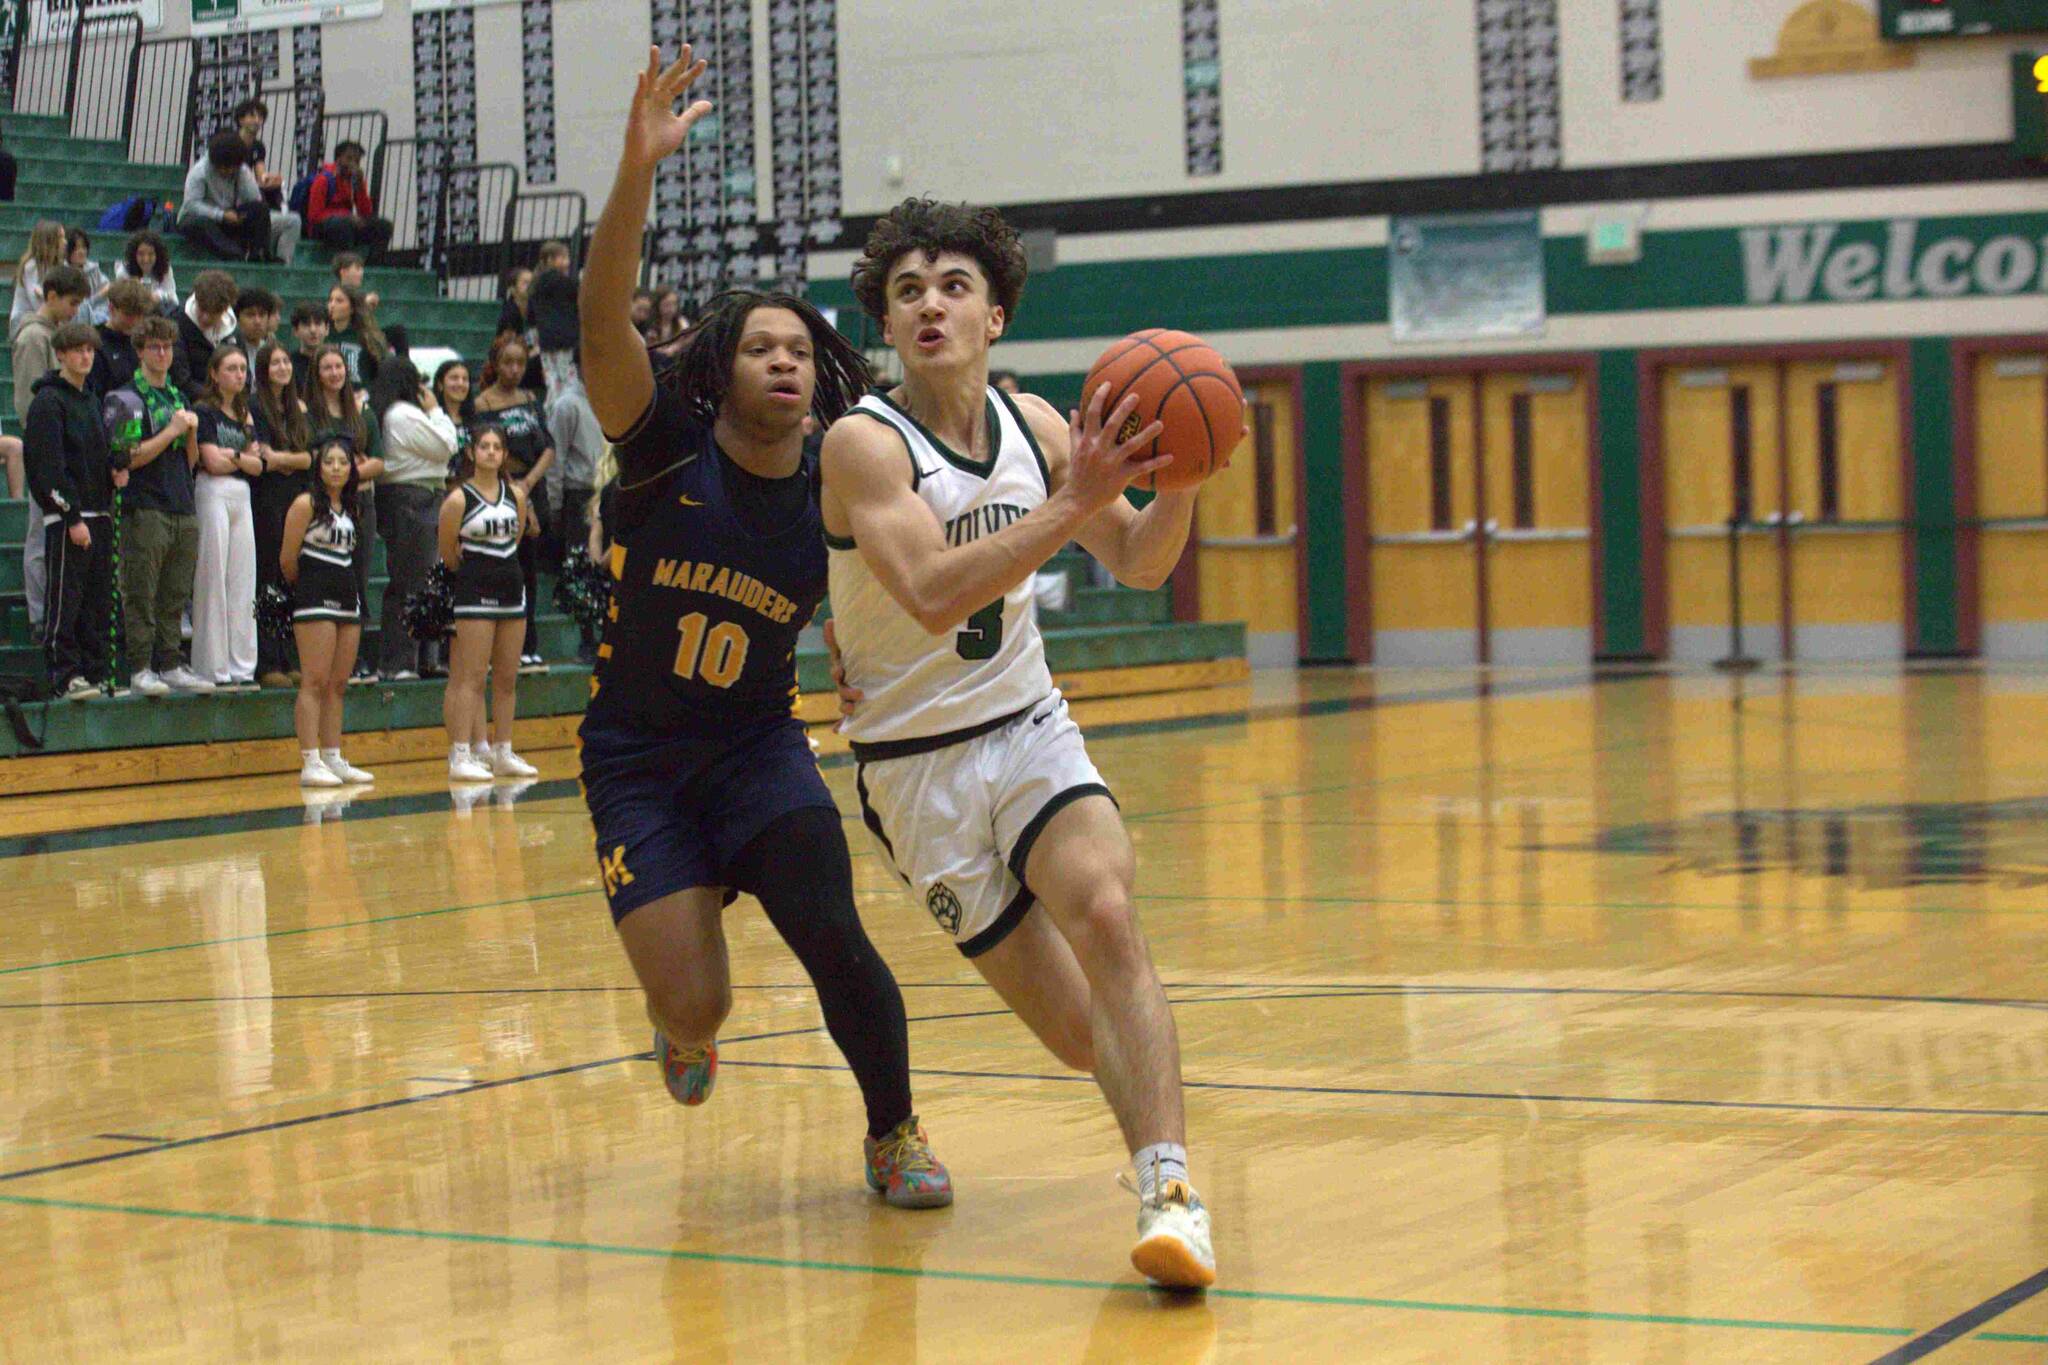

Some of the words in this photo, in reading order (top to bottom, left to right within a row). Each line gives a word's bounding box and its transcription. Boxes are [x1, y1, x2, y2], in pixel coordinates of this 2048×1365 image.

[1740, 218, 2048, 301] Welco
[652, 558, 798, 624] MARAUDERS
[673, 611, 750, 689] 10
[956, 595, 1004, 660] 3
